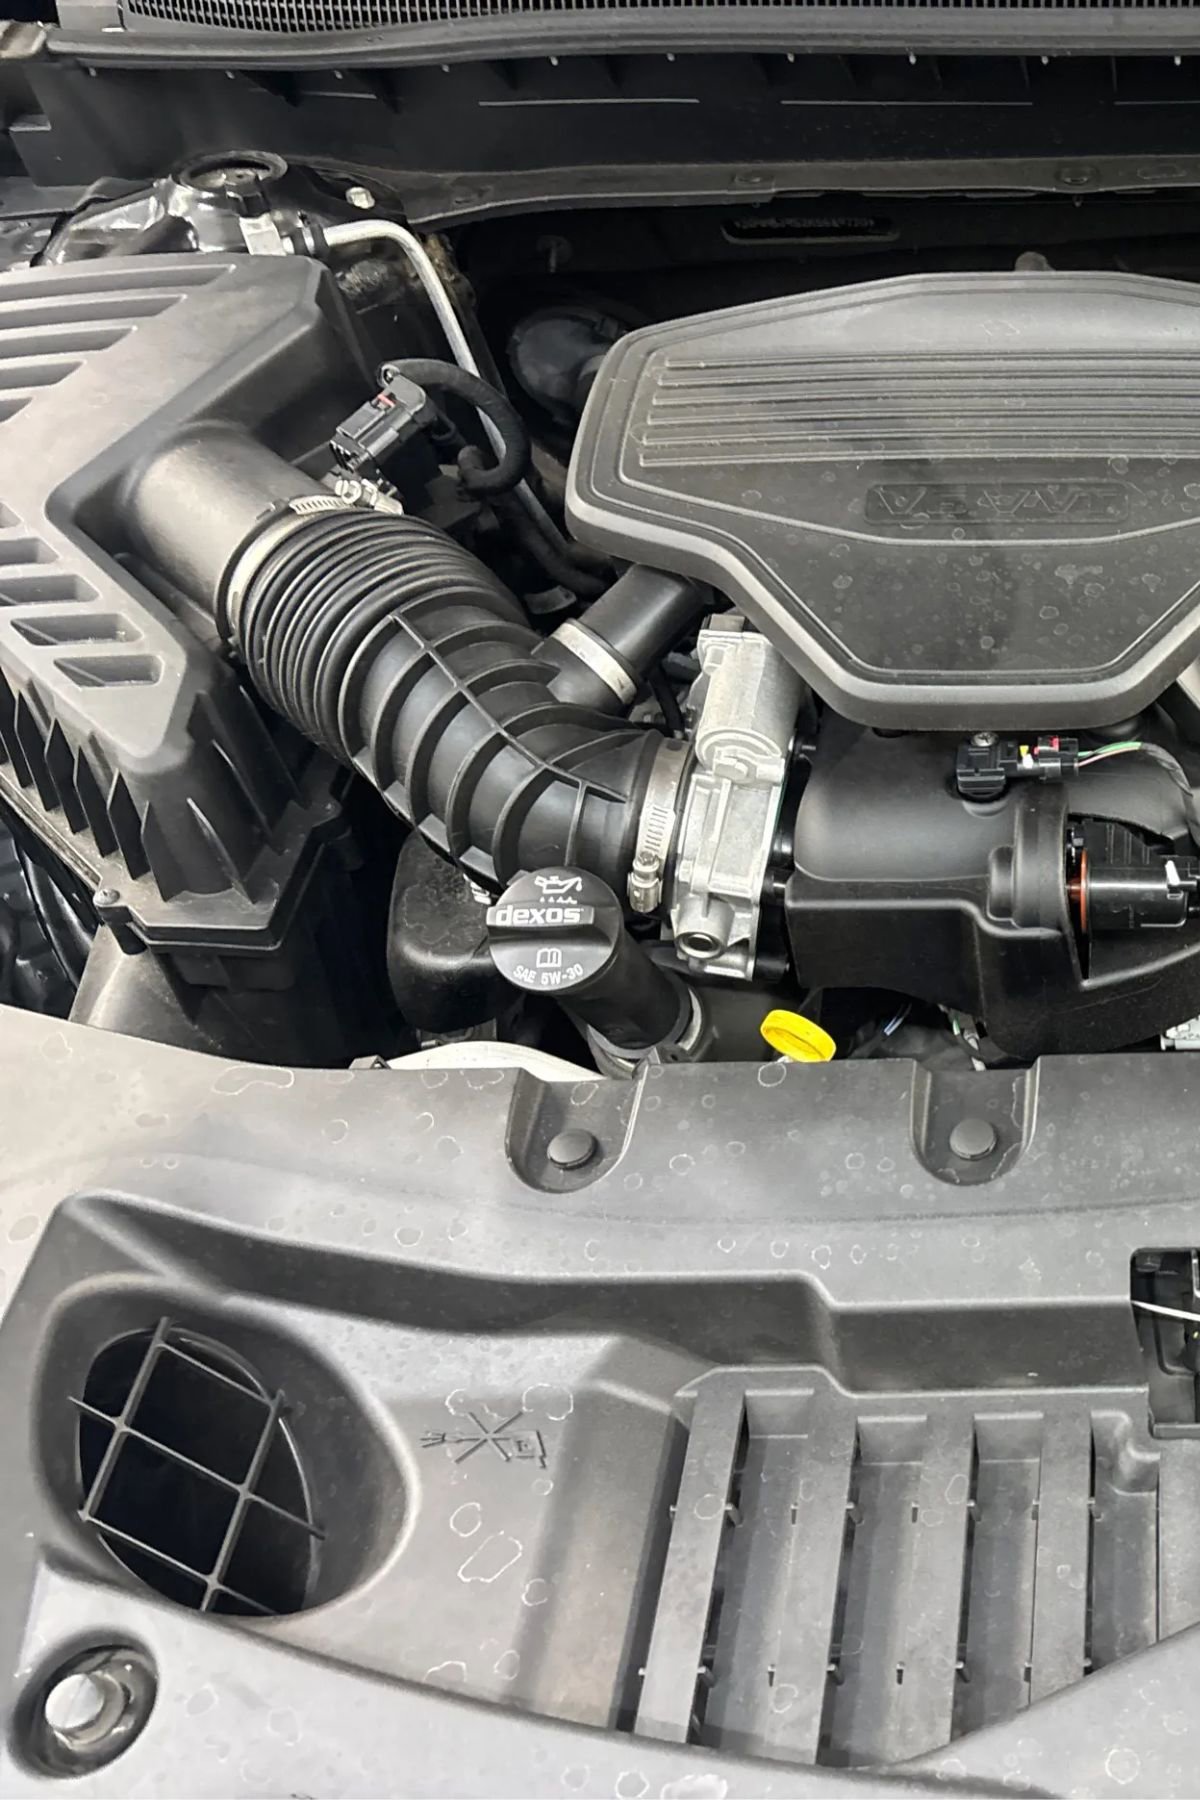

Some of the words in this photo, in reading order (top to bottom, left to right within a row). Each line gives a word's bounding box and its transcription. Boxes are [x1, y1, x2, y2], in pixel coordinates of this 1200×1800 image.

[495, 904, 581, 926] dexos
[513, 965, 537, 984] SAE
[540, 963, 584, 985] 5W-30
